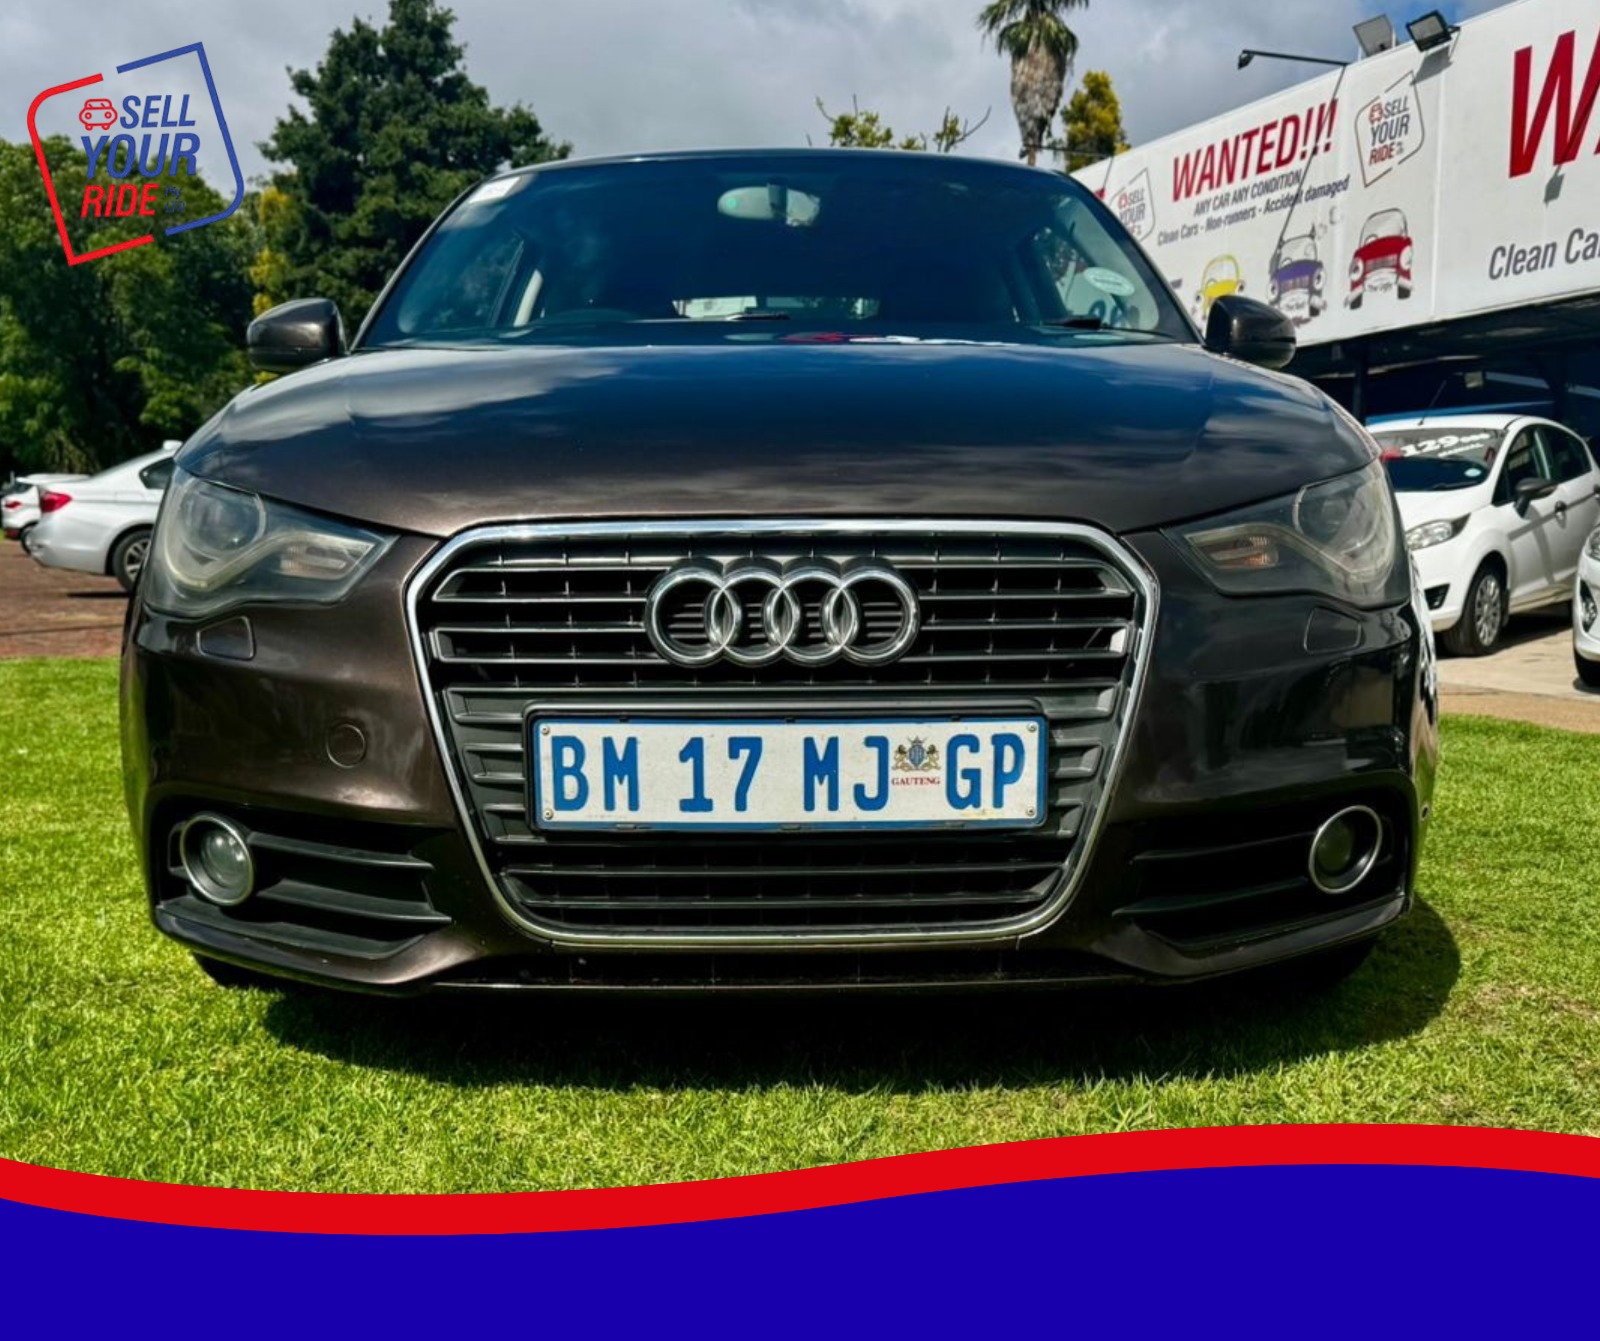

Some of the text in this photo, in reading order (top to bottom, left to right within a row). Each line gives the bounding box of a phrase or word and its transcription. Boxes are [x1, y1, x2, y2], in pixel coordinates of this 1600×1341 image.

[1383, 95, 1410, 119] SELL
[1370, 113, 1410, 147] YOUR
[1172, 98, 1338, 202] WANTED!!!
[1368, 141, 1395, 166] RIDE
[1180, 222, 1200, 240] Cars
[1204, 205, 1257, 233] Non-runners
[1304, 173, 1351, 204] damaged
[1212, 190, 1231, 211] CAR
[1231, 184, 1251, 205] ANY
[1250, 168, 1302, 199] CONDITION
[1488, 243, 1559, 281] Clean
[551, 734, 1025, 812] BM 17 MJ GP
[891, 777, 941, 787] GAUTENG
